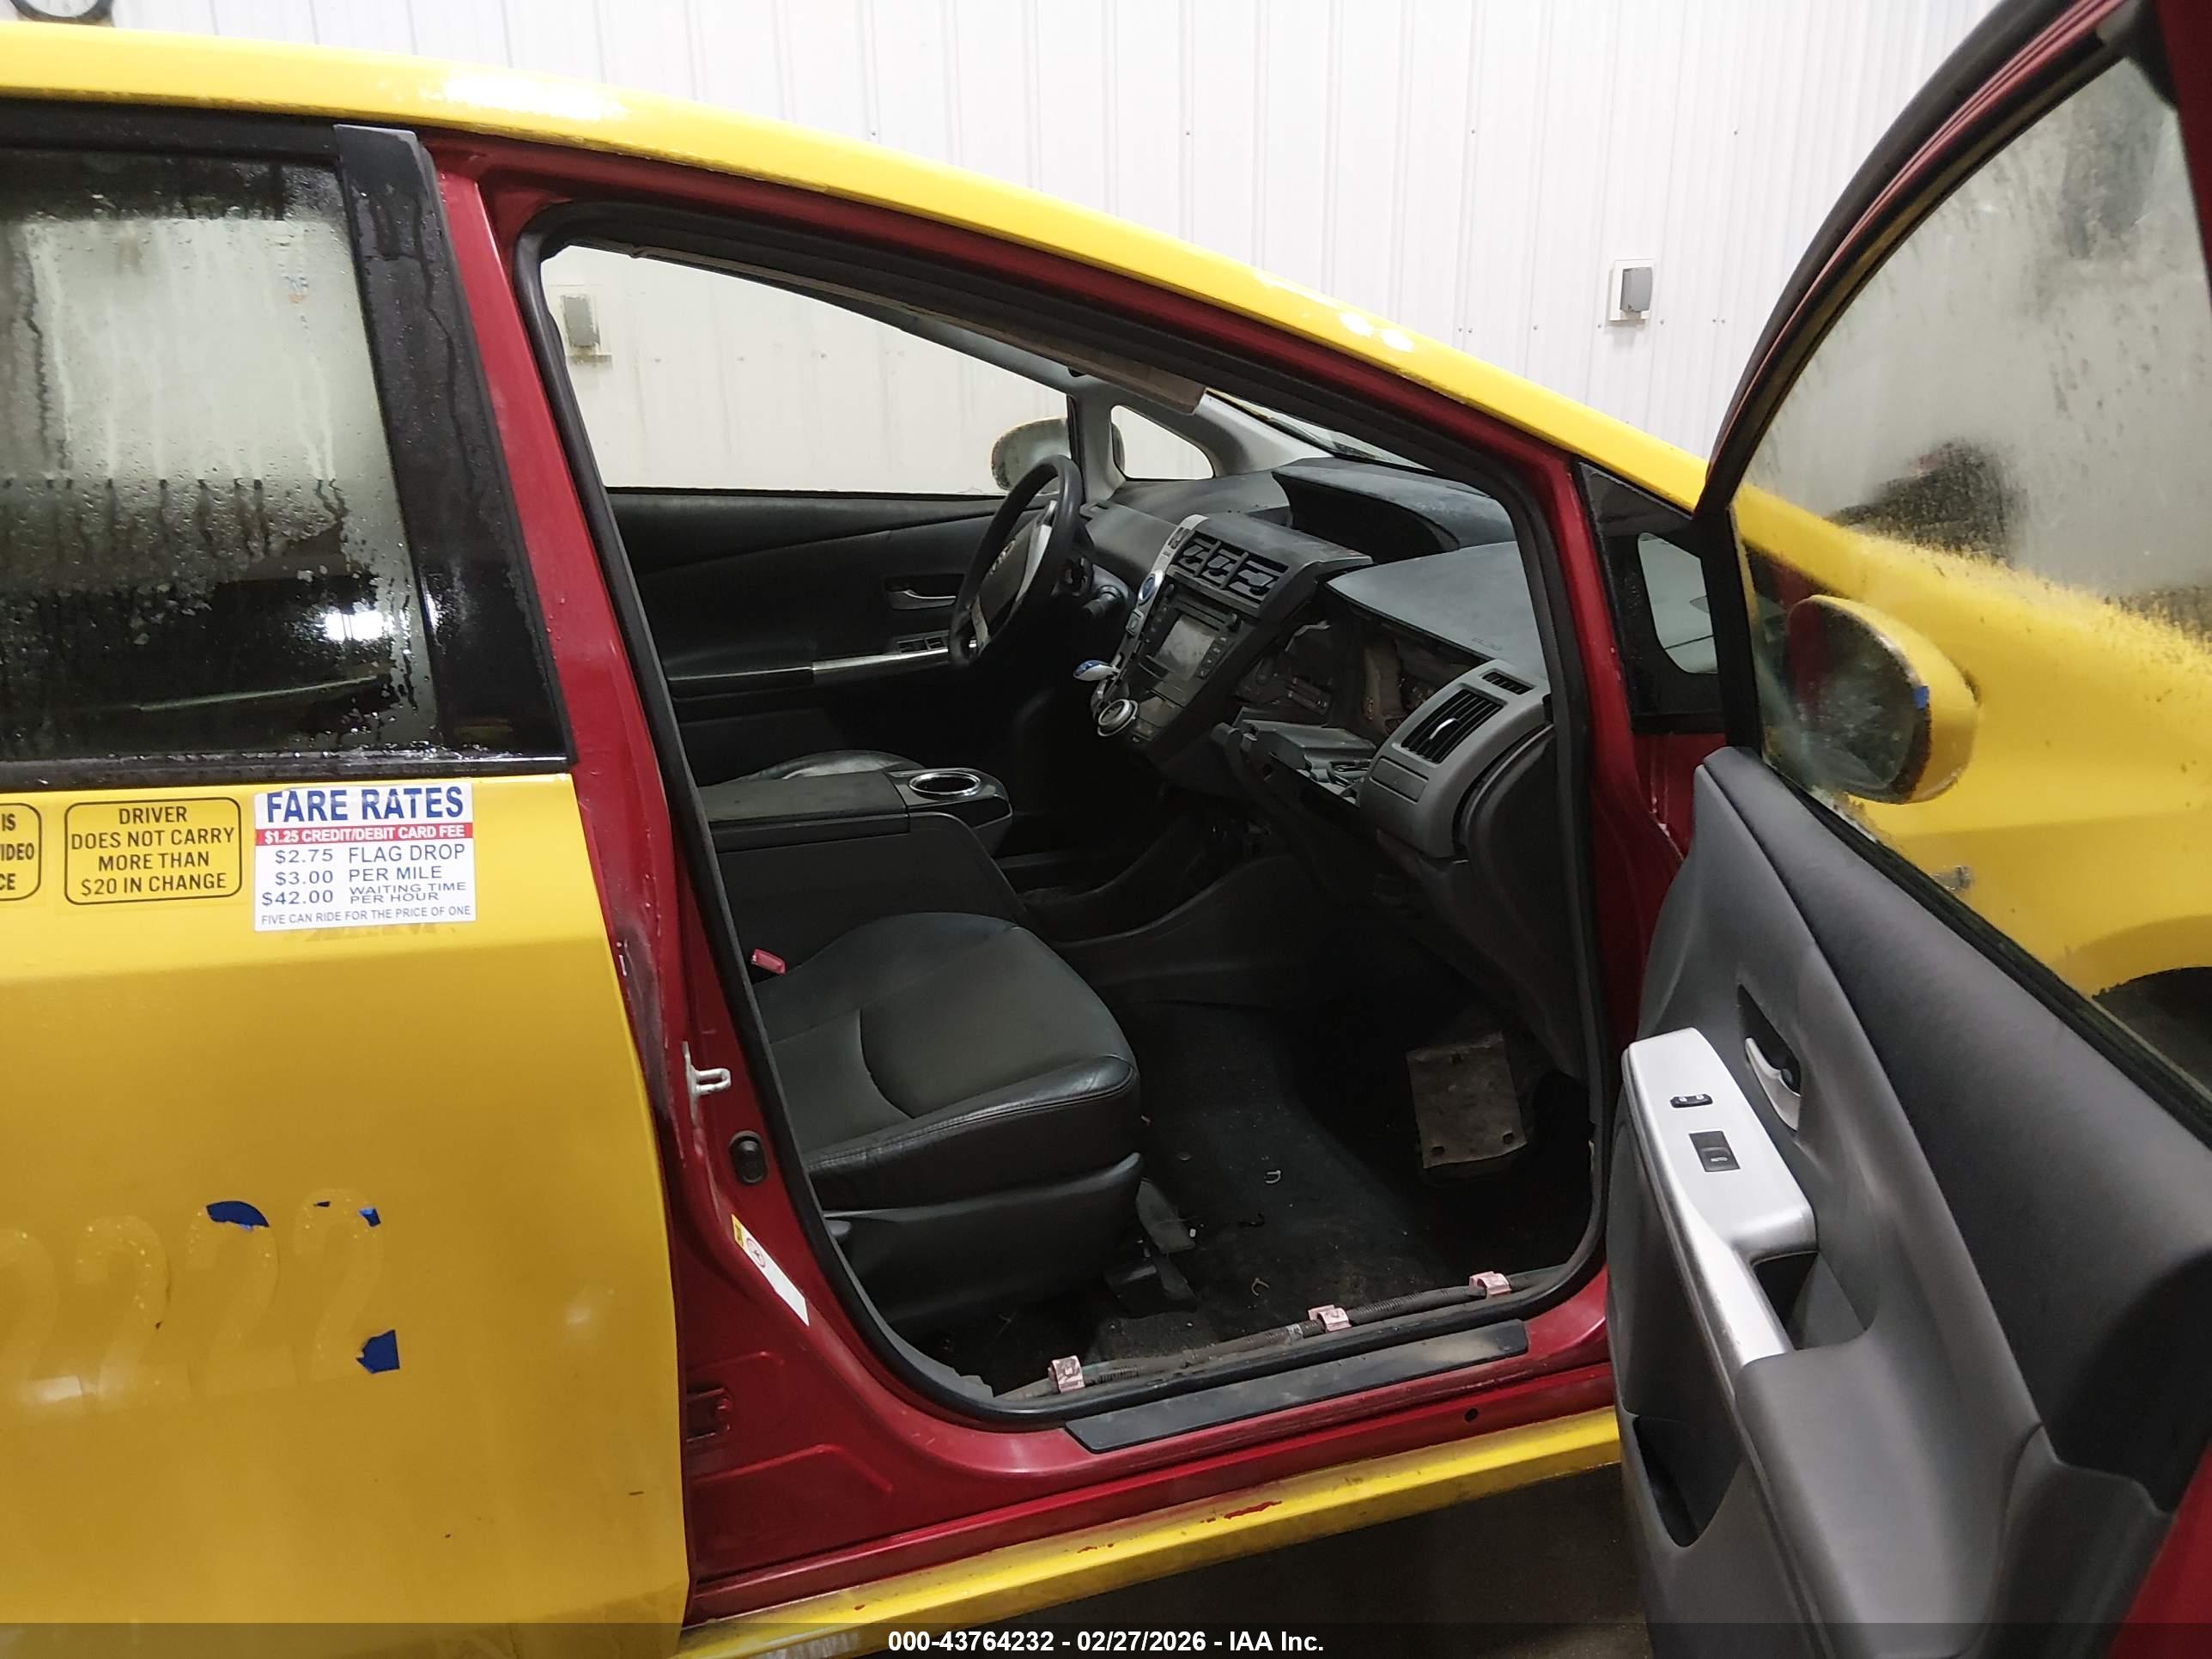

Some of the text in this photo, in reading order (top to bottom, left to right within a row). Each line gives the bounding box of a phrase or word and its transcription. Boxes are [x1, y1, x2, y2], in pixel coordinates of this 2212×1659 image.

[119, 806, 187, 824] DRIVER
[267, 787, 464, 823] FARE RATES
[71, 828, 234, 850] DOES NOT CARRY
[264, 824, 465, 844] $1.25 CREDIT/DEBIT CARD FEE
[0, 842, 34, 861] IDEO
[99, 851, 210, 872] MORE THAN
[275, 843, 465, 864] $2.75 FLAG DROP
[81, 872, 227, 897] $20 IN CHANGE
[275, 866, 442, 886] $3.00 PER MILE
[261, 890, 333, 907] $42.00
[349, 882, 467, 895] WAITING TIME
[349, 892, 439, 904] PER HOUR
[261, 905, 471, 925] FIVE CAN RIDE FOR THE PRICE OF ONE
